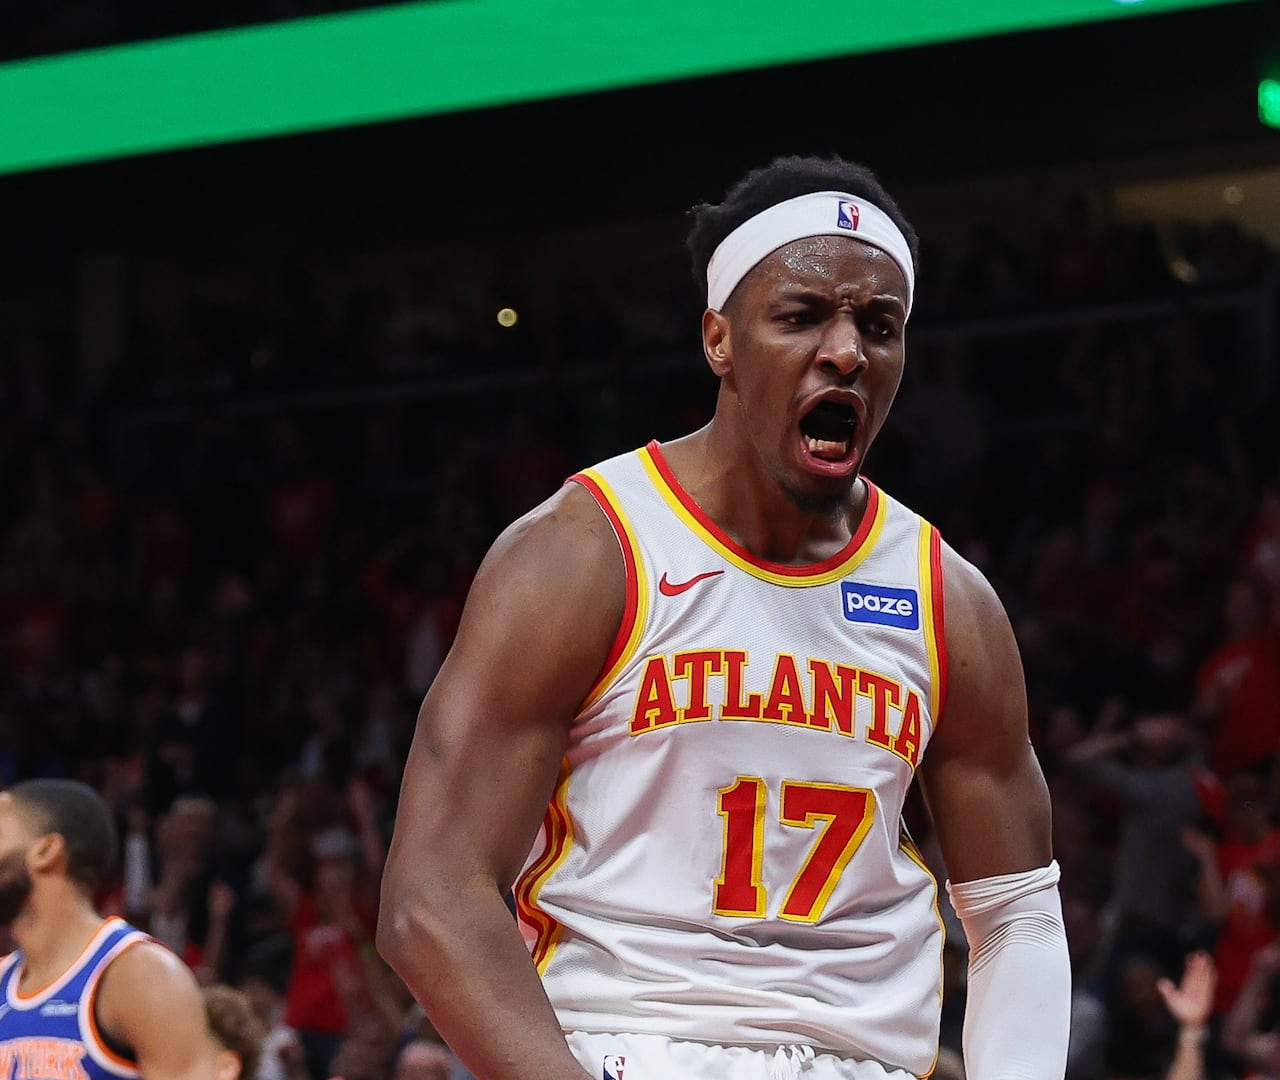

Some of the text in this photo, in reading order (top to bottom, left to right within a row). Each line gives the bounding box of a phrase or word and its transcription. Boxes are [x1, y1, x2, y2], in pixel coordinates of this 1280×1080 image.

[846, 592, 913, 617] paze
[629, 649, 923, 773] ATLANTA
[712, 775, 877, 926] 17
